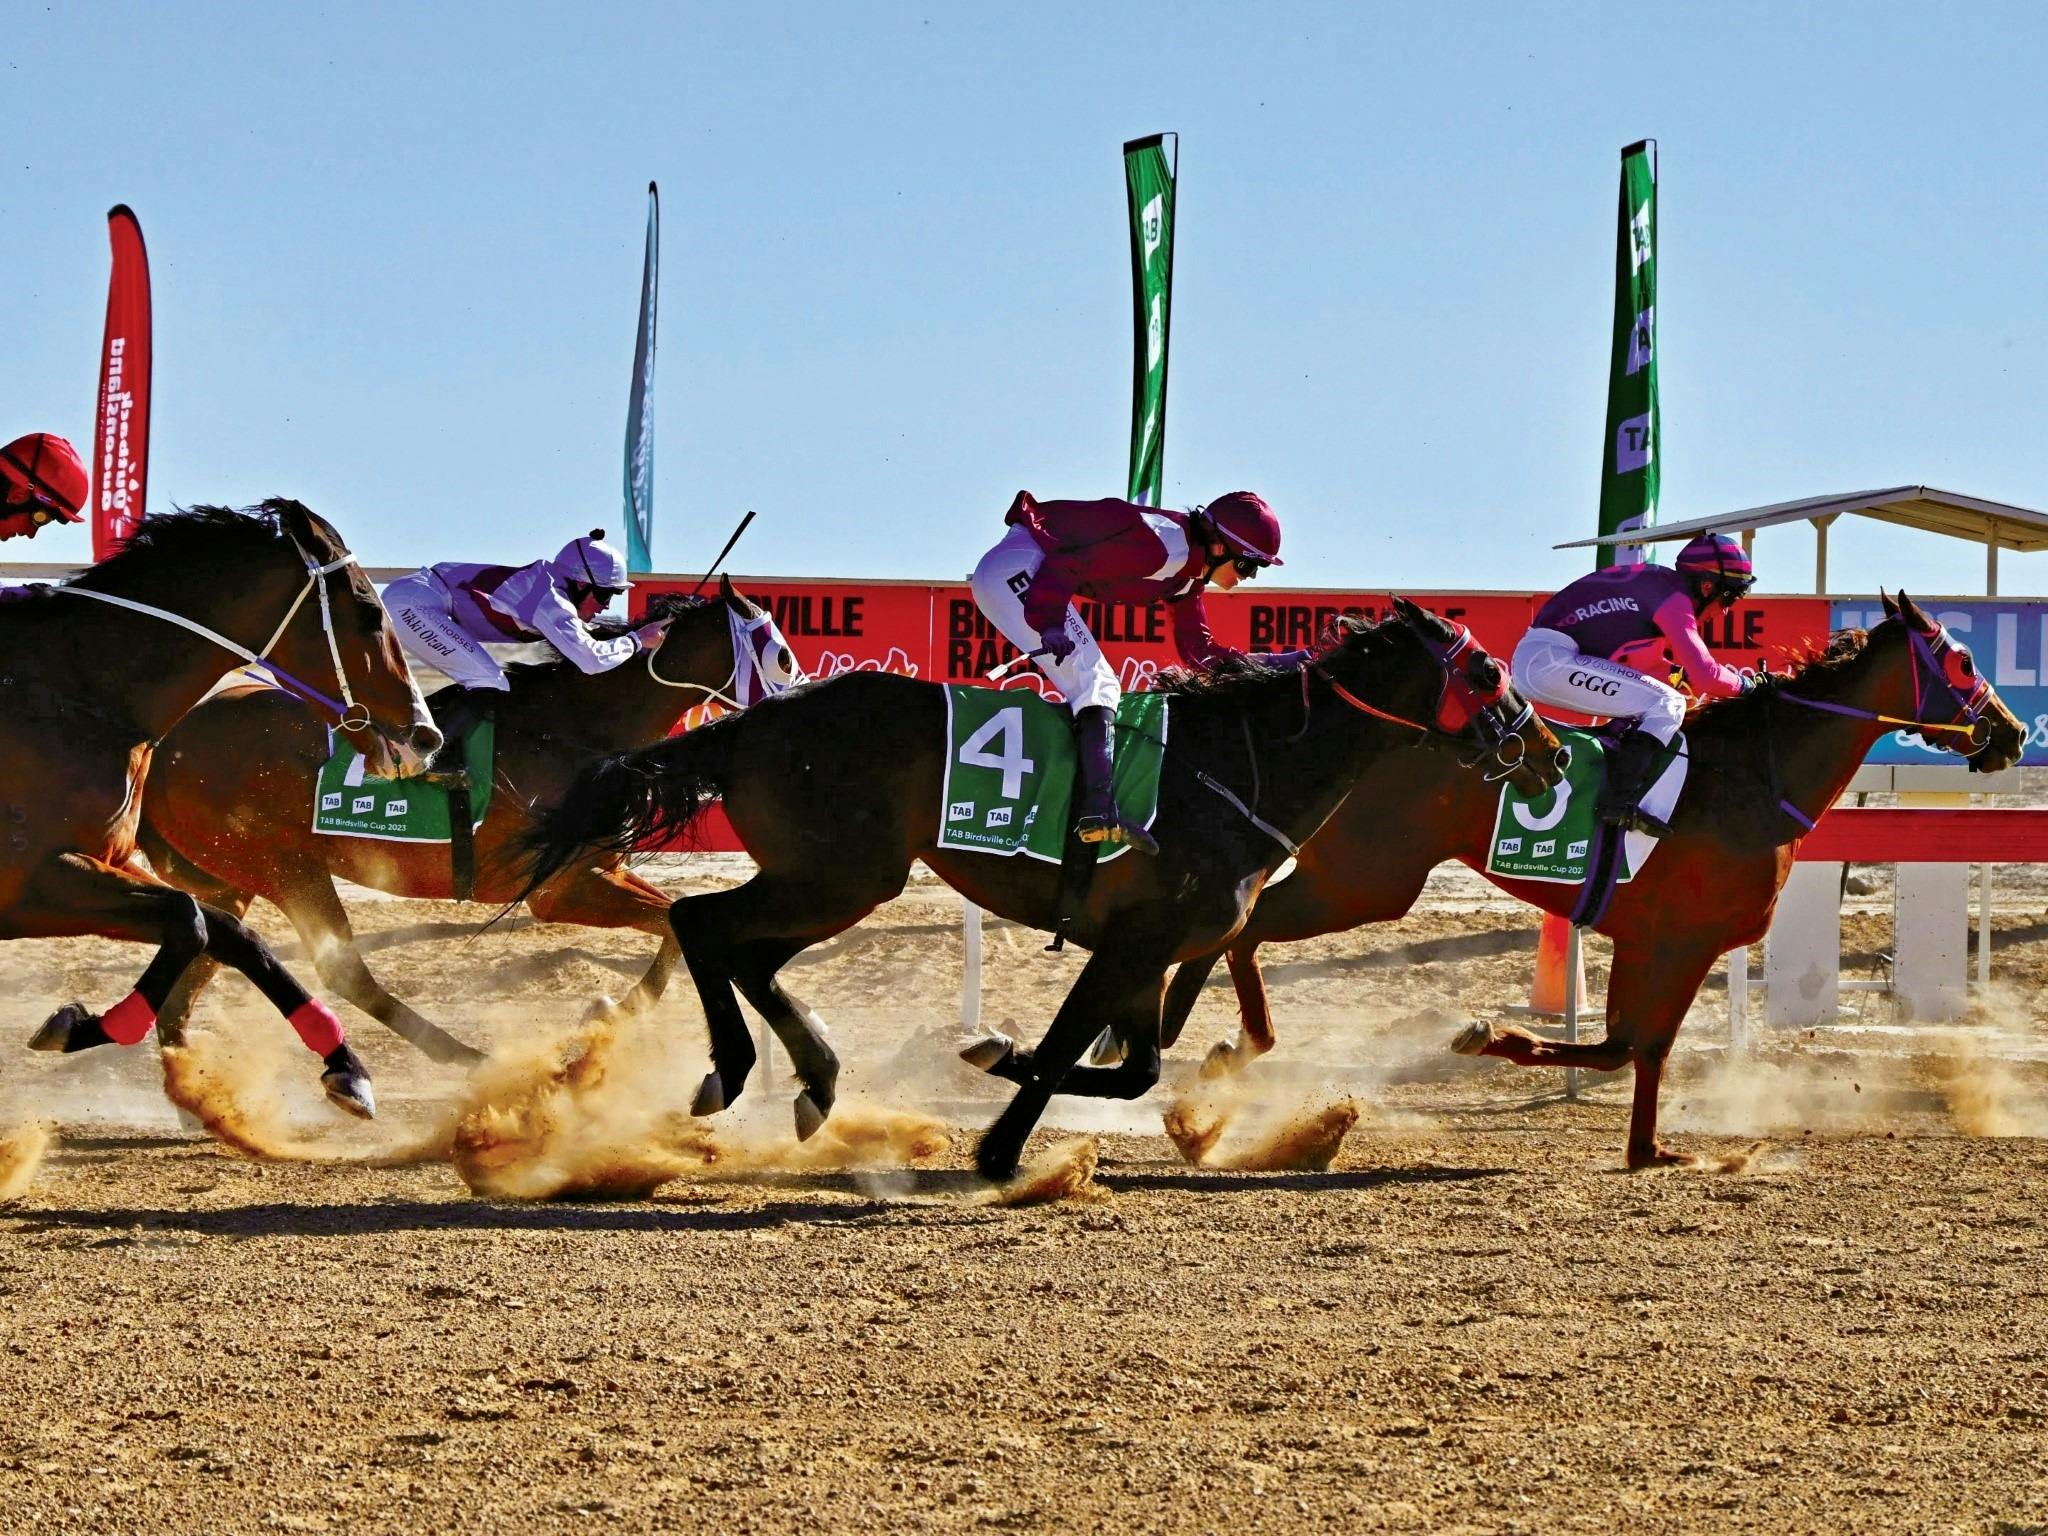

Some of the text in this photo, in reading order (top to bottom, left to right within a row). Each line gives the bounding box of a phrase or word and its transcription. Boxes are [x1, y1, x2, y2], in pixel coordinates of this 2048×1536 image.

[1568, 671, 1621, 697] GGG
[959, 707, 1034, 800] 4
[324, 796, 405, 813] TAB TAB TAB
[952, 805, 1010, 823] TAB TAB
[320, 816, 407, 832] TAB Birdsville Cup 2023
[946, 828, 964, 839] TAB
[964, 831, 1004, 845] Birdsville
[1501, 841, 1586, 855] TAB TAB TAB
[1495, 859, 1511, 869] TAB
[1512, 862, 1549, 872] Birdsville
[1550, 865, 1567, 874] Cup
